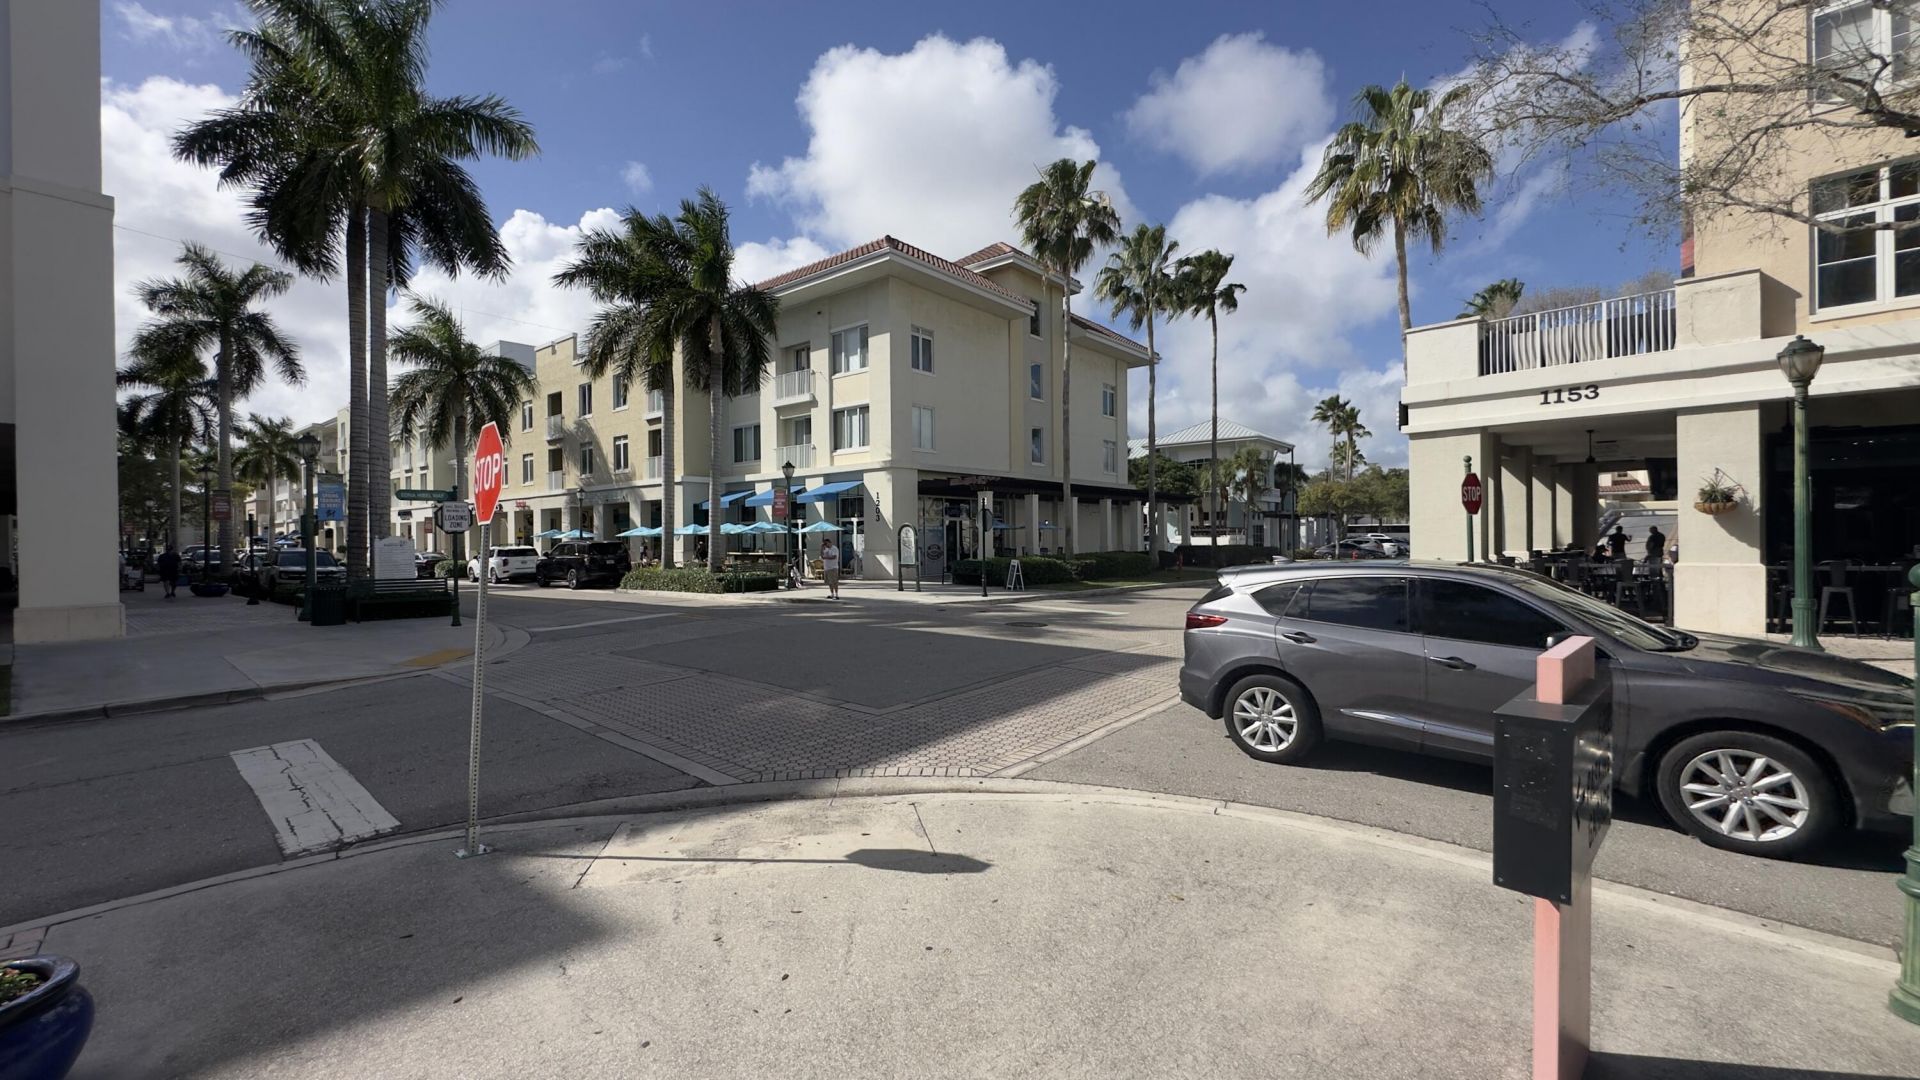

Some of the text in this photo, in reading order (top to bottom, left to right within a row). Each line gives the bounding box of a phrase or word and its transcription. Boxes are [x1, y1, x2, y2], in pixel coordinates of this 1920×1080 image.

[1540, 384, 1600, 405] 1153
[474, 453, 501, 494] STOP
[1462, 486, 1481, 502] STOP
[444, 514, 468, 522] LOADING
